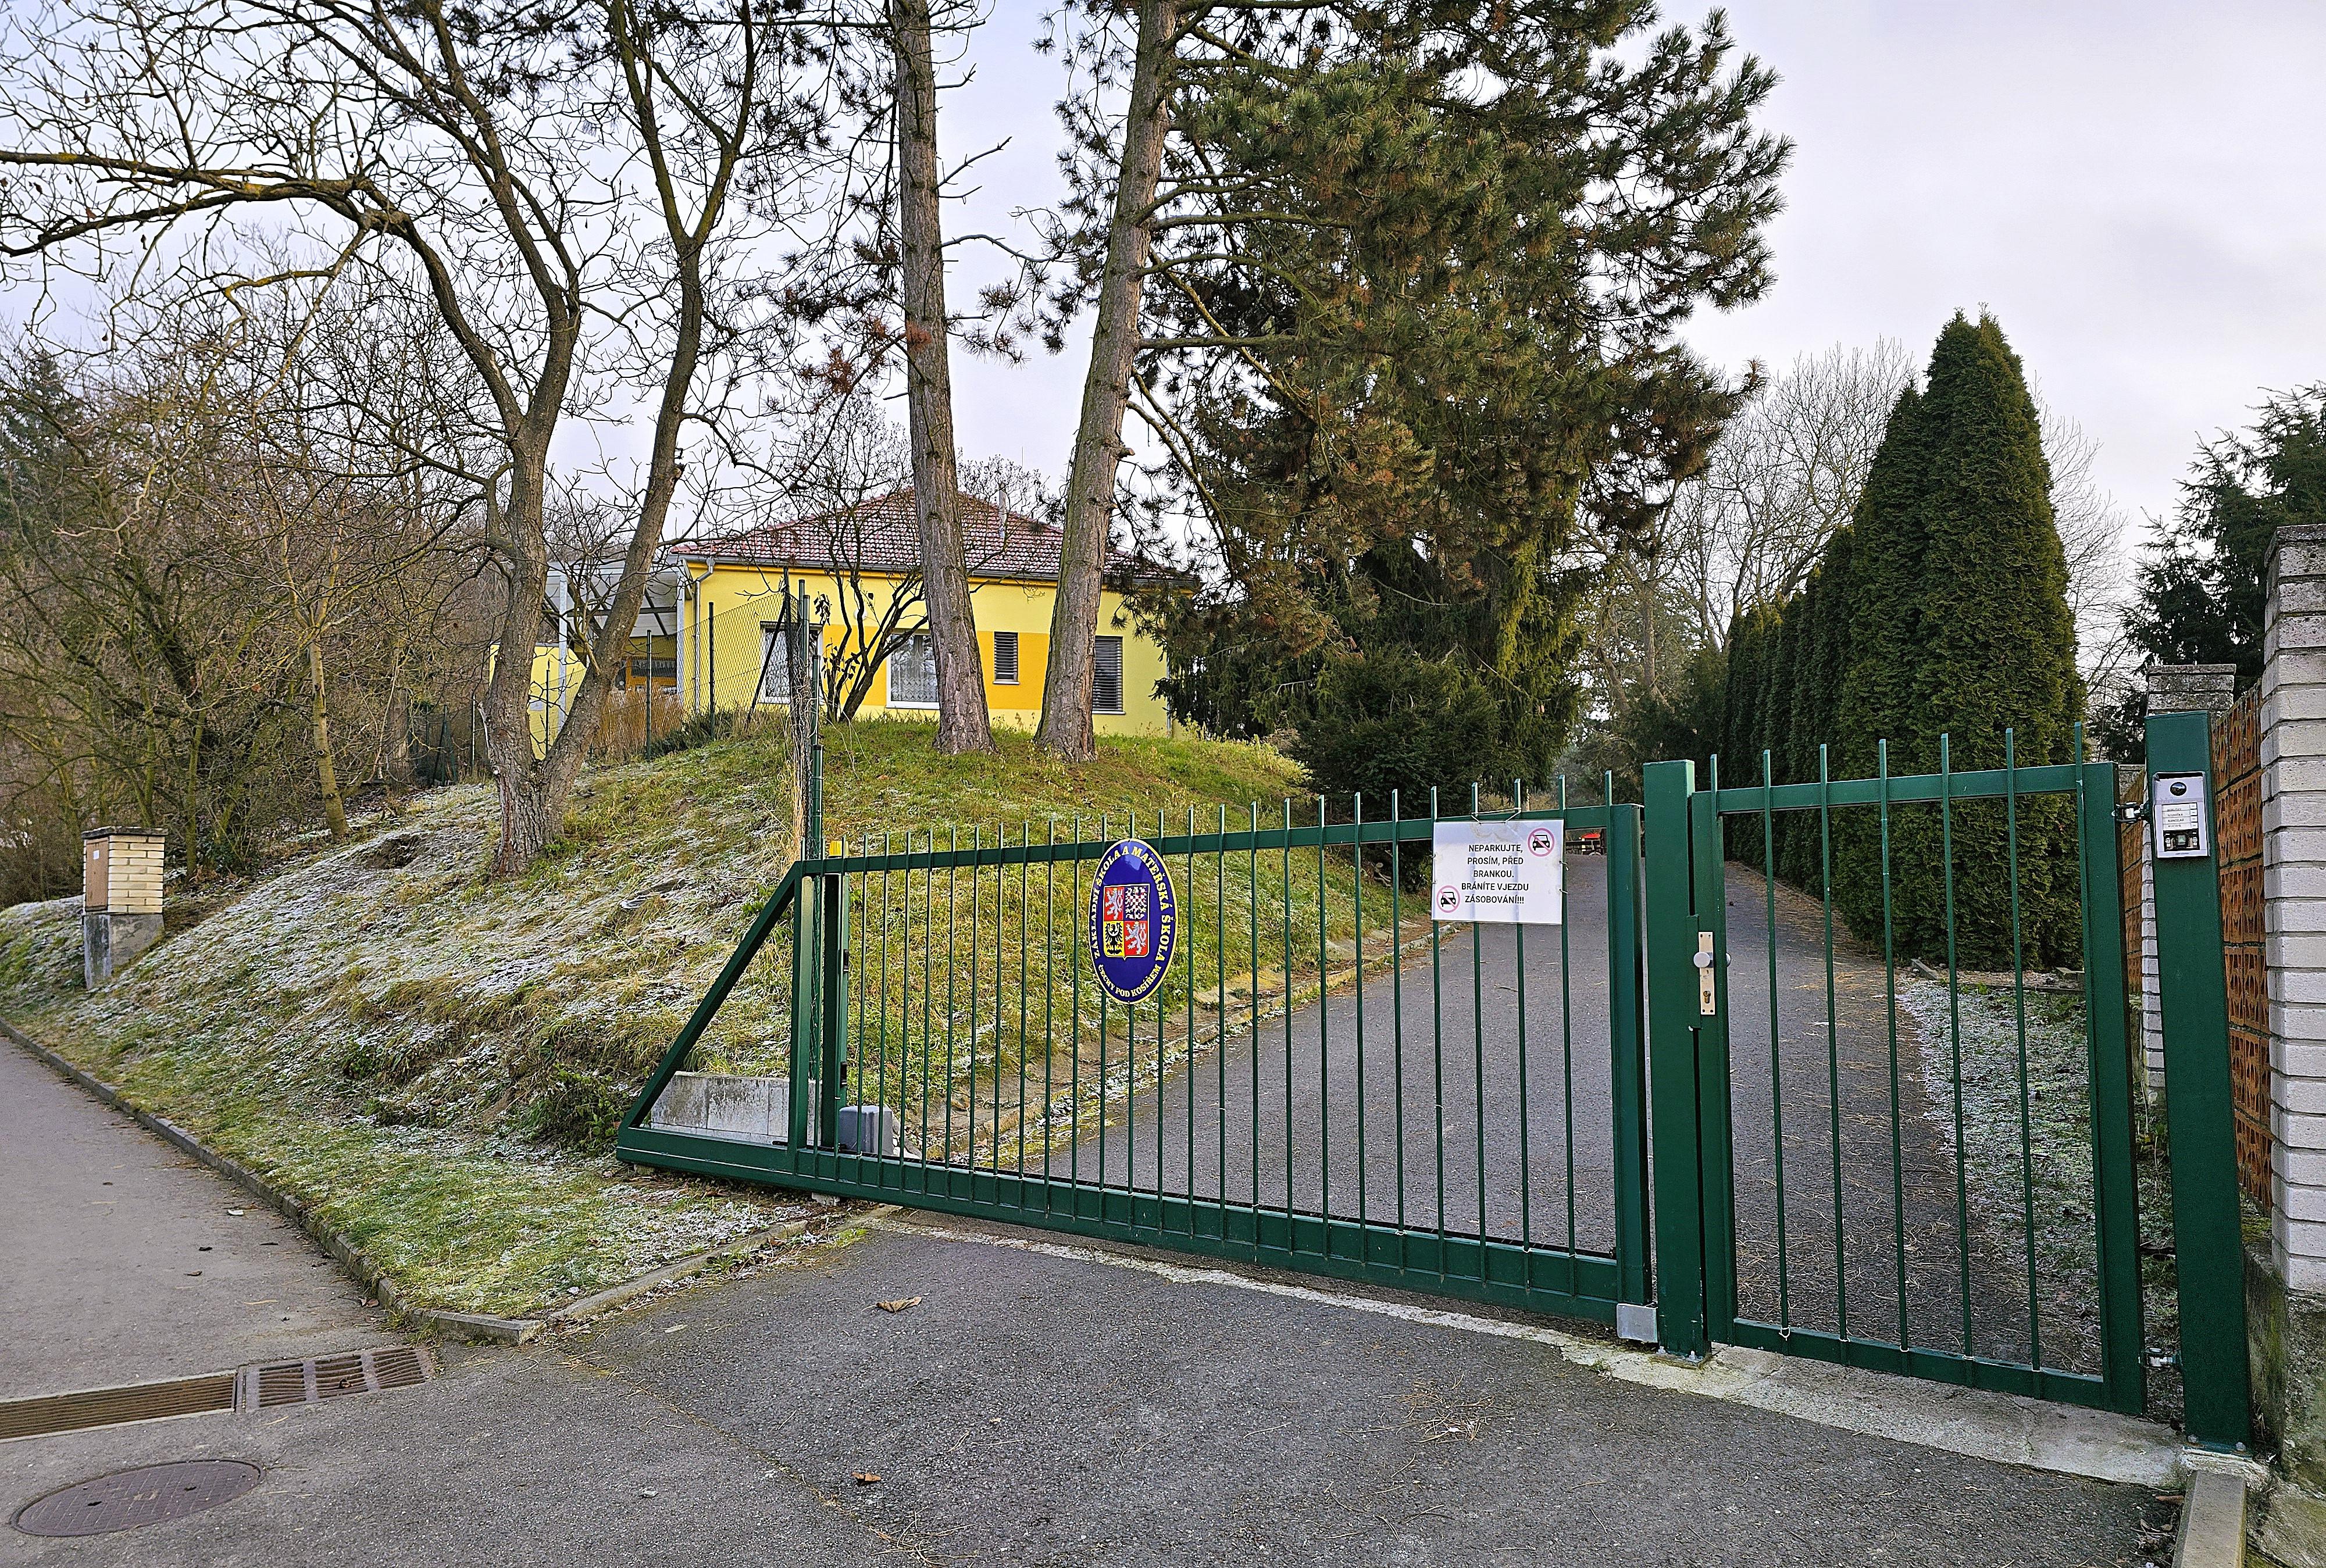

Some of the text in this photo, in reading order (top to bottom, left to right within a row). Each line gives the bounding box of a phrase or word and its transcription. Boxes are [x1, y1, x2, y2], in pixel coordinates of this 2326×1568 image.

[1468, 844, 1523, 853] NEPARKUJTE,
[1467, 855, 1524, 866] PROSÍM, PŘED
[1473, 870, 1515, 878] BRANKOU.
[1461, 881, 1529, 891] BRÁNÍTE VJEZDU
[1091, 845, 1174, 961] ZÁKLADNÍ ŠKOLA A MATEŘSKÁ ŠKOLA
[1465, 894, 1525, 904] ZÁSOBOVÁNÍ!!!
[1098, 963, 1162, 997] ČECHY POD KOSÍŘEM
